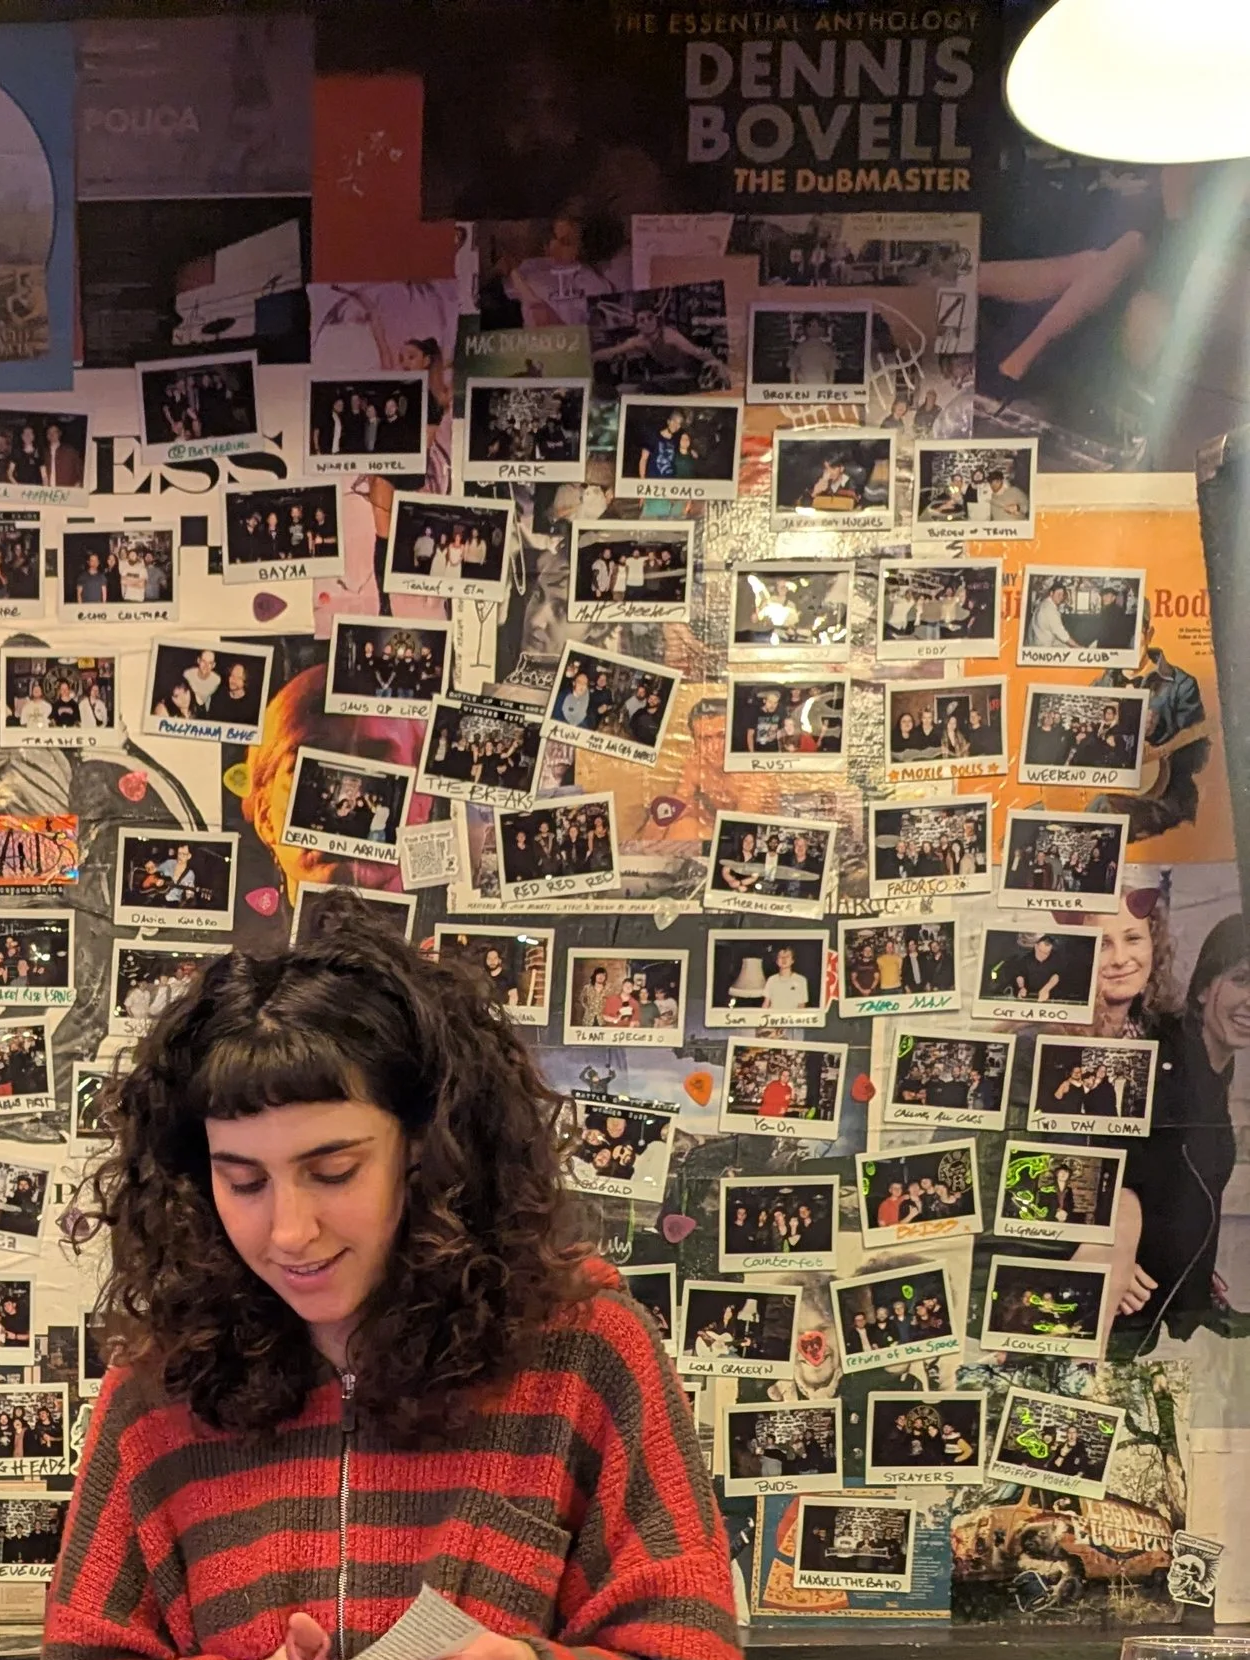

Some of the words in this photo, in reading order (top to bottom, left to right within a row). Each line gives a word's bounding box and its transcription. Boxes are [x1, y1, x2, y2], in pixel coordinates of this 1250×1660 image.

[669, 12, 800, 33] ESSENTIAL
[814, 12, 978, 31] ANTHOLOGY
[685, 37, 974, 99] DENNIS
[686, 104, 972, 164] BOVELL
[734, 170, 784, 194] THE
[796, 169, 971, 193] DuBMASTER
[465, 335, 494, 356] MAC
[369, 461, 406, 470] HOTEL
[498, 465, 546, 477] PARK
[984, 528, 1018, 536] TRUTH
[917, 645, 948, 657] EDDY
[1022, 650, 1071, 664] MONDAY
[22, 736, 97, 746] TRASHED
[751, 759, 800, 770] RUST
[950, 764, 983, 777] DOLLS
[285, 831, 318, 846] DEAD
[352, 842, 399, 860] ARRIVAL
[511, 884, 540, 900] RED
[546, 878, 576, 893] RED
[1027, 899, 1083, 908] KYTELER
[993, 1008, 1017, 1018] CUT
[1019, 1008, 1035, 1019] LA
[1039, 1009, 1068, 1020] ROC
[575, 1031, 605, 1042] PLANT
[1033, 1117, 1057, 1130] TWO
[1071, 1120, 1095, 1132] DAY
[689, 1362, 719, 1372] LOLA
[883, 1471, 955, 1483] STRAYERS
